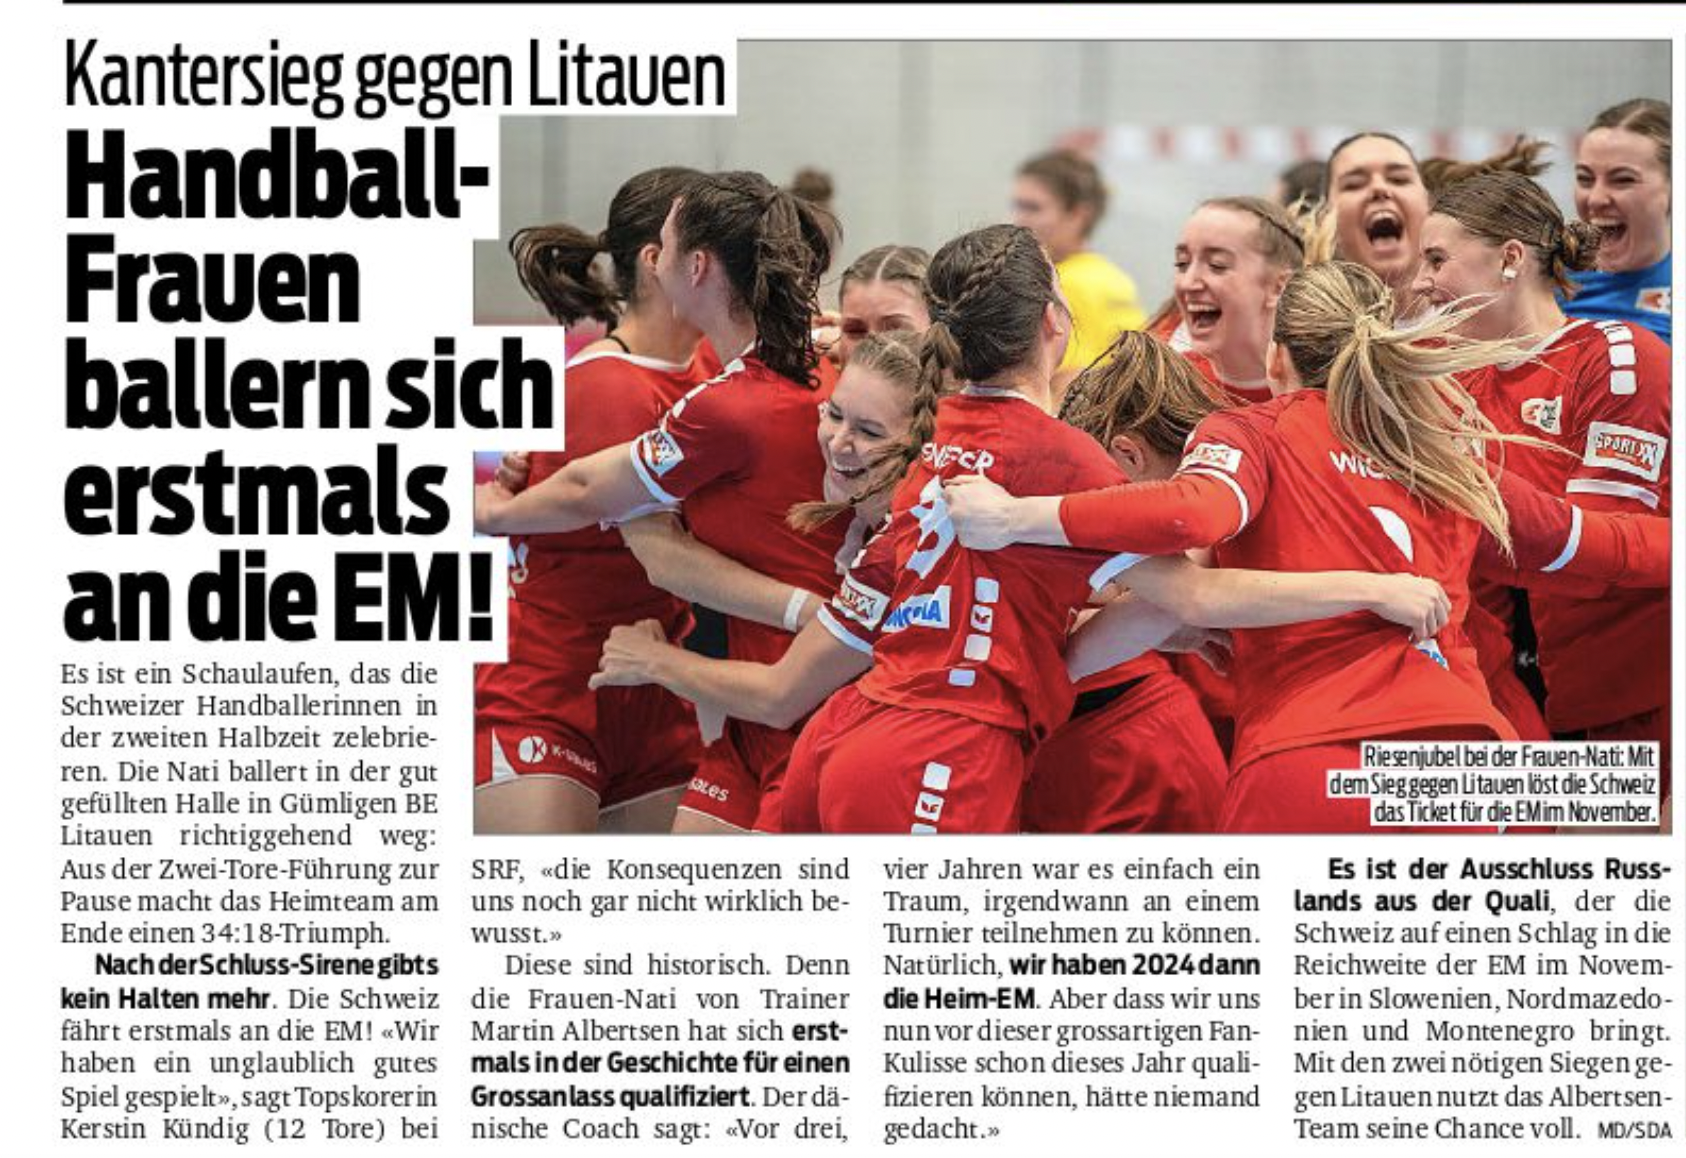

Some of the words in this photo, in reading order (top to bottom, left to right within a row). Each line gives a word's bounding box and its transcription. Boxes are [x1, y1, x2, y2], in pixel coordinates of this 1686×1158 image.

[66, 38, 345, 119] Kantersieg
[354, 52, 513, 119] gegen
[529, 38, 725, 107] Litauen
[66, 126, 490, 220] Handball-
[66, 232, 360, 324] Frauen
[65, 336, 371, 430] ballern
[384, 336, 554, 430] sich
[63, 442, 451, 536] erstmals
[63, 570, 171, 643] an
[187, 548, 318, 642] die
[334, 551, 493, 642] EM!
[61, 663, 89, 684] Es
[97, 662, 125, 684] ist
[135, 661, 172, 684] ein
[183, 661, 340, 688] Schaulaufen,
[350, 661, 391, 684] das
[401, 661, 438, 684] die
[62, 693, 185, 716] Schweizer
[197, 693, 401, 716] Handballerinnen
[416, 693, 438, 716] in
[60, 725, 102, 748] der
[112, 725, 208, 748] zweiten
[219, 725, 321, 748] Halbzeit
[333, 725, 437, 748] zelebrie-
[61, 791, 168, 820] gefüllten
[176, 791, 240, 814] Halle
[248, 791, 272, 814] in
[280, 791, 397, 820] Gümligen
[406, 793, 438, 814] BE
[61, 823, 153, 846] Litauen
[180, 823, 352, 852] richtiggehend
[379, 829, 436, 852] weg:
[60, 859, 106, 880] Aus
[111, 856, 153, 880] der
[159, 857, 391, 886] Zwei-Tore-Führung
[399, 863, 440, 880] zur
[472, 859, 525, 881] SRF,
[541, 856, 591, 880] «die
[608, 859, 782, 886] Konsequenzen
[798, 856, 850, 880] sind
[883, 857, 929, 880] vier
[938, 857, 1023, 880] Jahren
[1032, 863, 1080, 880] war
[1087, 863, 1114, 880] es
[1124, 857, 1214, 880] einfach
[1224, 857, 1261, 880] ein
[1328, 857, 1356, 880] Es
[1367, 857, 1397, 880] ist
[1408, 856, 1449, 880] der
[1459, 856, 1594, 880] Ausschluss
[1605, 857, 1672, 880] Russ-
[883, 890, 969, 916] Traum,
[984, 888, 1129, 918] irgendwann
[1143, 895, 1171, 912] an
[1185, 889, 1260, 912] einem
[1294, 888, 1362, 912] lands
[1374, 894, 1418, 912] aus
[1431, 888, 1472, 912] der
[1485, 888, 1556, 917] Quali,
[1575, 888, 1616, 912] der
[1634, 888, 1671, 912] die
[471, 926, 562, 944] wusst.»
[883, 921, 974, 944] Turnier
[982, 920, 1118, 944] teilnehmen
[1126, 927, 1154, 944] zu
[1162, 920, 1260, 944] können.
[506, 953, 572, 975] Diese
[584, 952, 633, 976] sind
[648, 952, 771, 976] historisch.
[786, 954, 850, 976] Denn
[1294, 952, 1427, 976] Reichweite
[1436, 952, 1478, 976] der
[1488, 954, 1526, 976] EM
[1537, 953, 1568, 976] im
[1579, 954, 1672, 976] Novem-
[61, 986, 110, 1010] kein
[119, 986, 200, 1010] Halten
[207, 986, 277, 1010] mehr.
[289, 987, 329, 1010] Die
[340, 986, 440, 1010] Schweiz
[61, 1018, 121, 1041] fährt
[128, 1018, 231, 1041] erstmals
[239, 1024, 270, 1041] an
[277, 1018, 315, 1041] die
[325, 1020, 372, 1041] EM!
[382, 1019, 440, 1041] «Wir
[472, 1019, 555, 1041] Martin
[562, 1018, 680, 1041] Albertsen
[688, 1018, 727, 1041] hat
[737, 1018, 784, 1041] sich
[791, 1020, 849, 1042] erst-
[1294, 1019, 1348, 1041] nien
[1362, 1018, 1409, 1041] und
[1426, 1020, 1575, 1048] Montenegro
[1590, 1018, 1670, 1048] bringt.
[61, 1050, 136, 1073] haben
[154, 1051, 191, 1073] ein
[210, 1050, 355, 1080] unglaublich
[373, 1056, 437, 1080] gutes
[1294, 1050, 1335, 1073] Mit
[1340, 1050, 1386, 1073] den
[1392, 1050, 1446, 1073] zwei
[1452, 1050, 1543, 1080] nötigen
[1550, 1050, 1631, 1080] Siegen
[1634, 1057, 1672, 1080] ge-
[884, 1084, 973, 1107] fizieren
[982, 1084, 1078, 1111] können,
[1086, 1084, 1148, 1107] hätte
[1154, 1084, 1260, 1107] niemand
[61, 1116, 146, 1139] Kerstin
[163, 1116, 249, 1145] Kündig
[264, 1118, 306, 1143] (12
[321, 1118, 385, 1141] Tore)
[401, 1116, 438, 1139] bei
[472, 1116, 548, 1139] nische
[563, 1116, 640, 1139] Coach
[654, 1122, 710, 1146] sagt:
[726, 1118, 780, 1139] «Vor
[794, 1116, 848, 1143] drei,
[884, 1116, 1000, 1145] gedacht.»
[1293, 1118, 1359, 1139] Team
[1366, 1116, 1429, 1139] seine
[1434, 1116, 1524, 1139] Chance
[1529, 1116, 1581, 1139] voll.
[1598, 1121, 1673, 1139] MD/SDA
